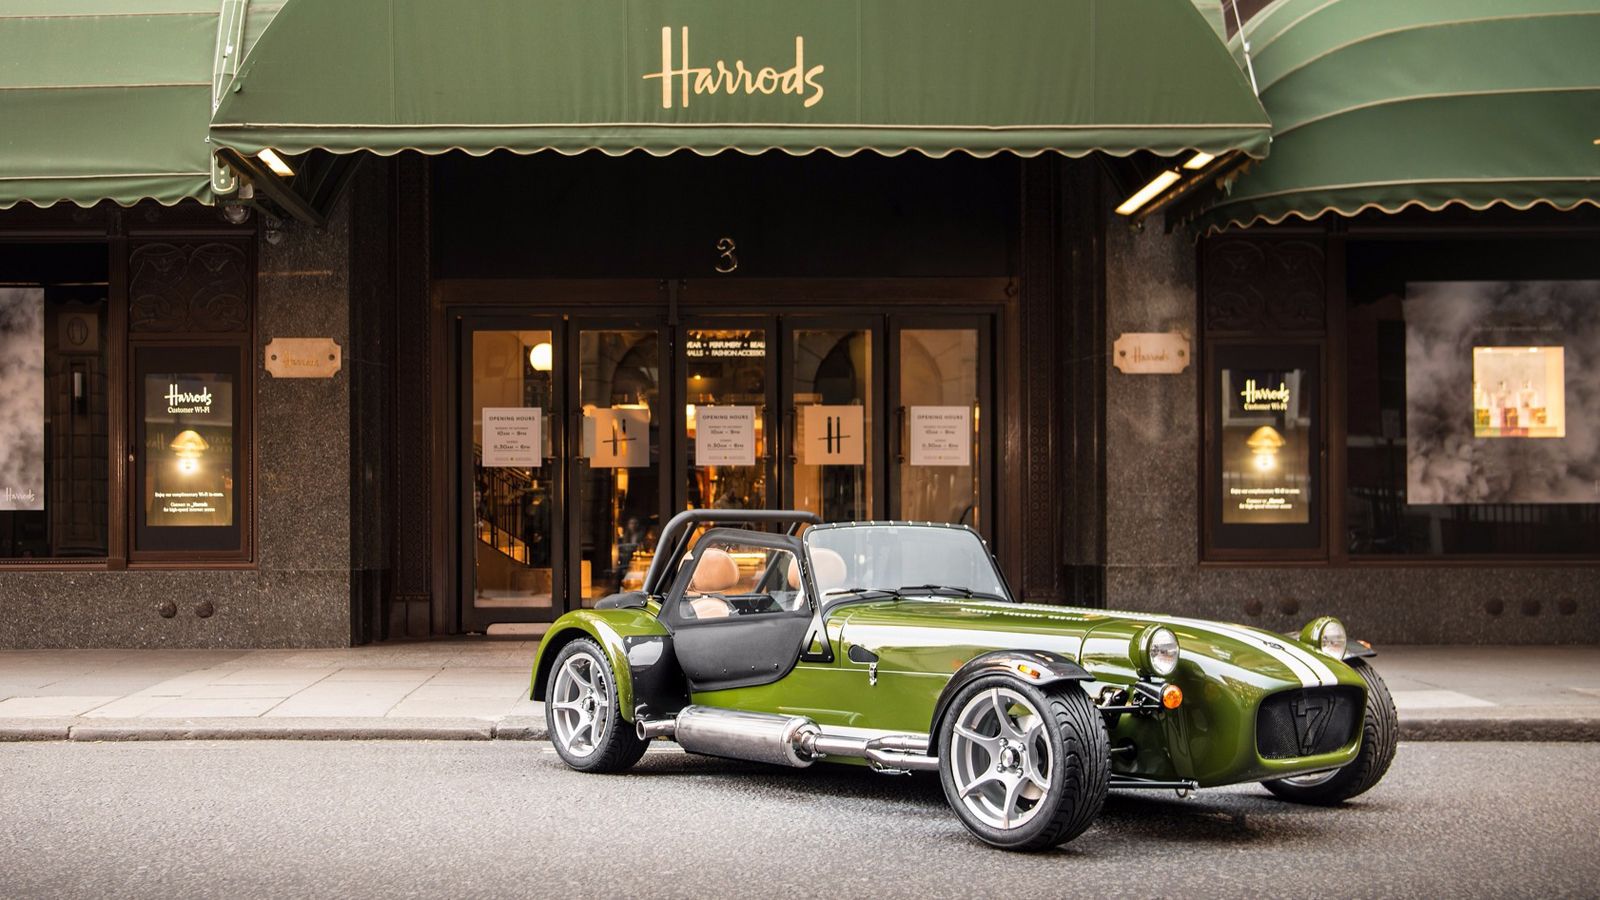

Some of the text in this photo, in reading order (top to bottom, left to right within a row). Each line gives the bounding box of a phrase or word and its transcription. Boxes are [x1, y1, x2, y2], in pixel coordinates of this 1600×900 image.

[642, 26, 824, 109] Harrods
[715, 238, 738, 273] 3
[708, 341, 743, 349] PERFUMERY
[164, 383, 212, 406] Harrods
[1241, 379, 1290, 403] Harrods
[168, 406, 194, 414] Customer
[4, 487, 35, 502] Harrods
